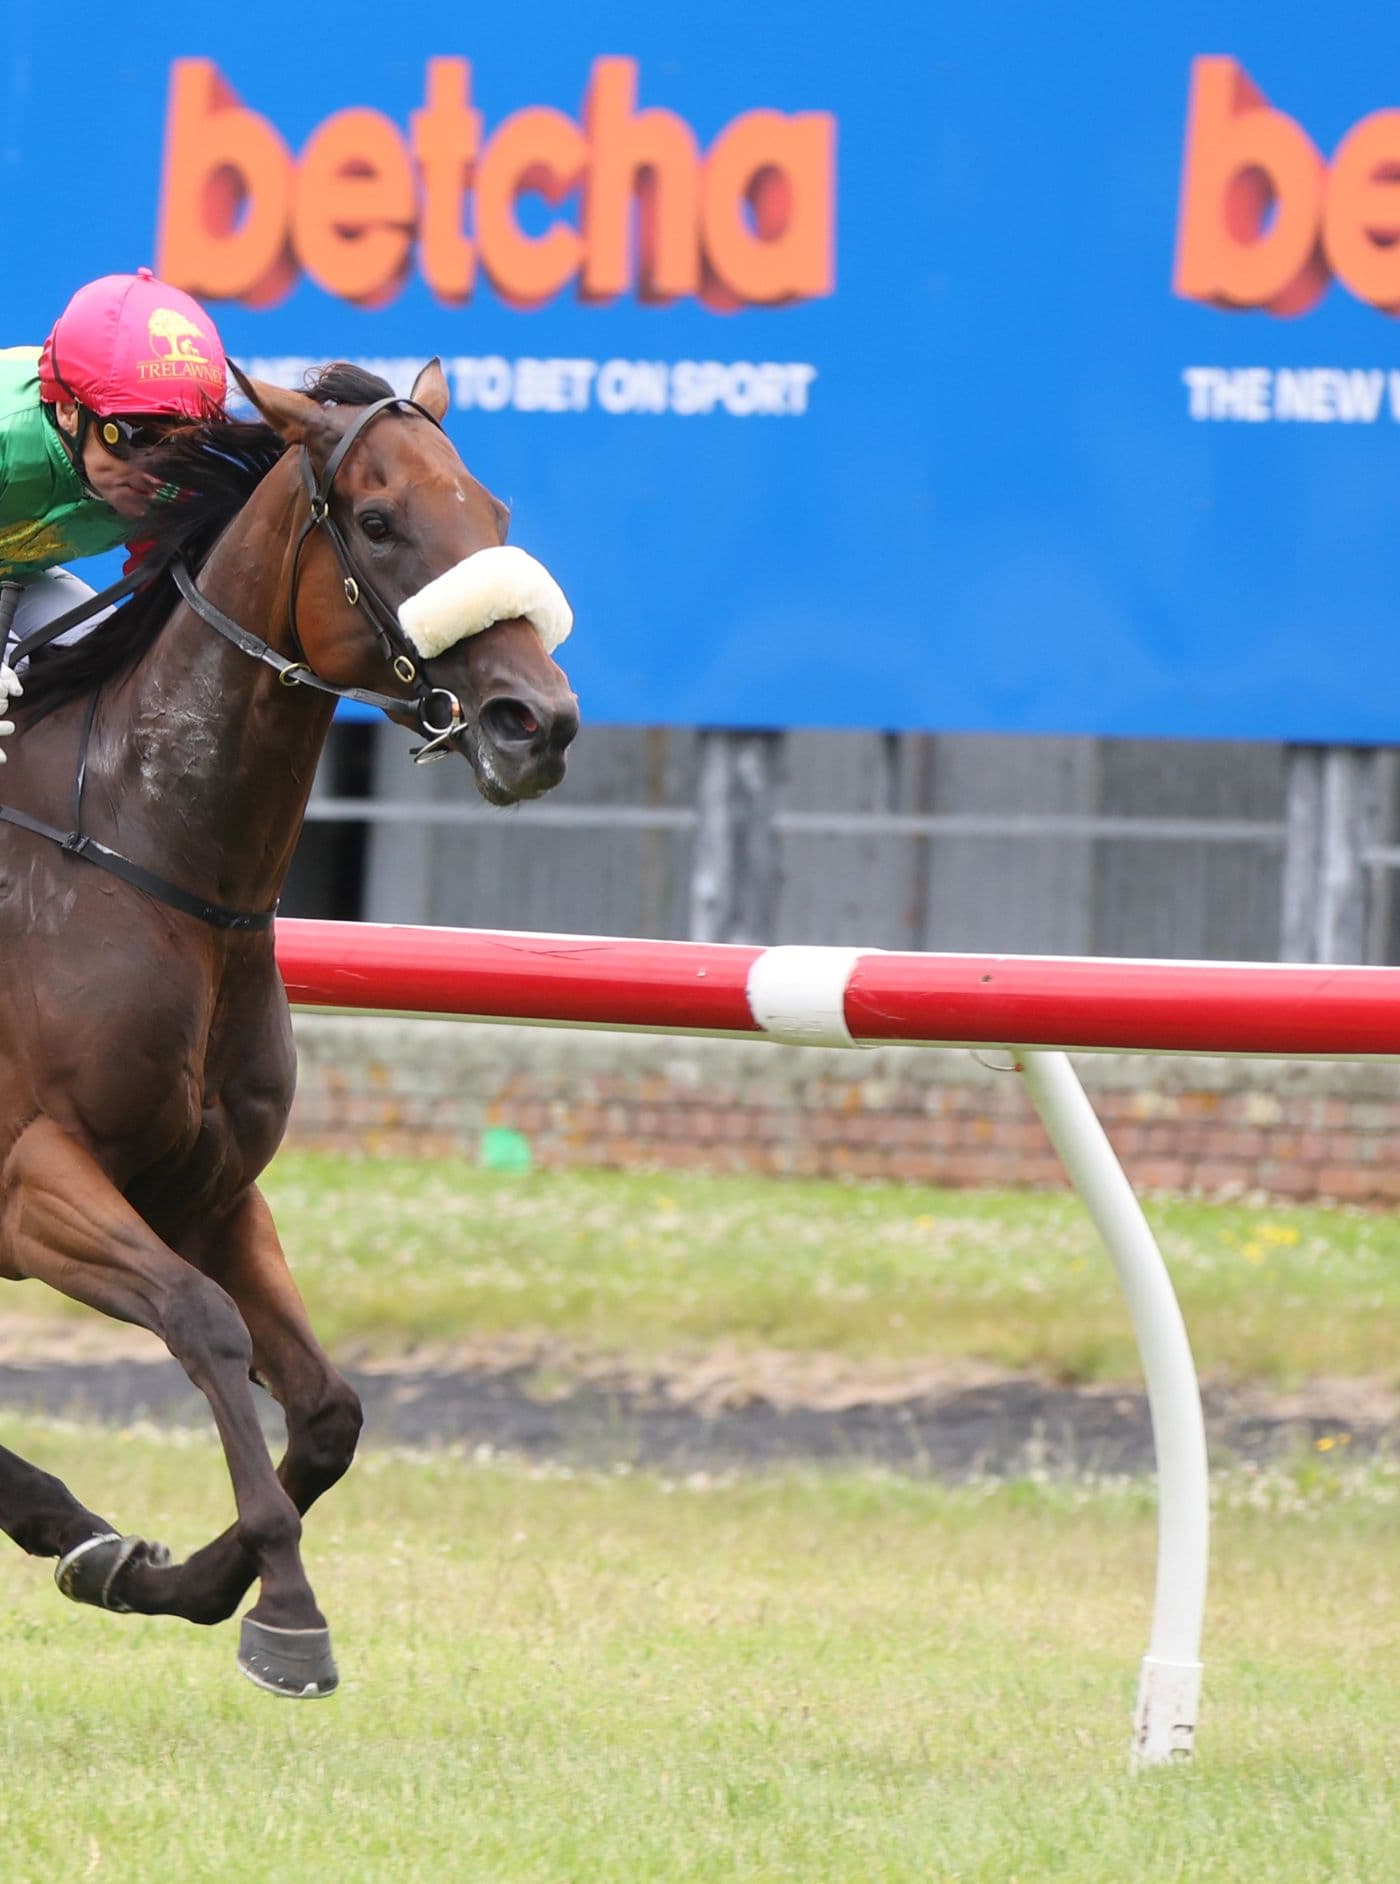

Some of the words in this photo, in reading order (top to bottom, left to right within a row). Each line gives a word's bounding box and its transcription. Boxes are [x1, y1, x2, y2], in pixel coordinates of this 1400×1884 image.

[153, 56, 838, 314] betcha
[451, 356, 511, 411] TO
[512, 357, 595, 413] BET
[596, 358, 669, 414] ON
[670, 360, 815, 416] SPORT
[1182, 366, 1271, 422] THE
[1273, 367, 1384, 424] NEW
